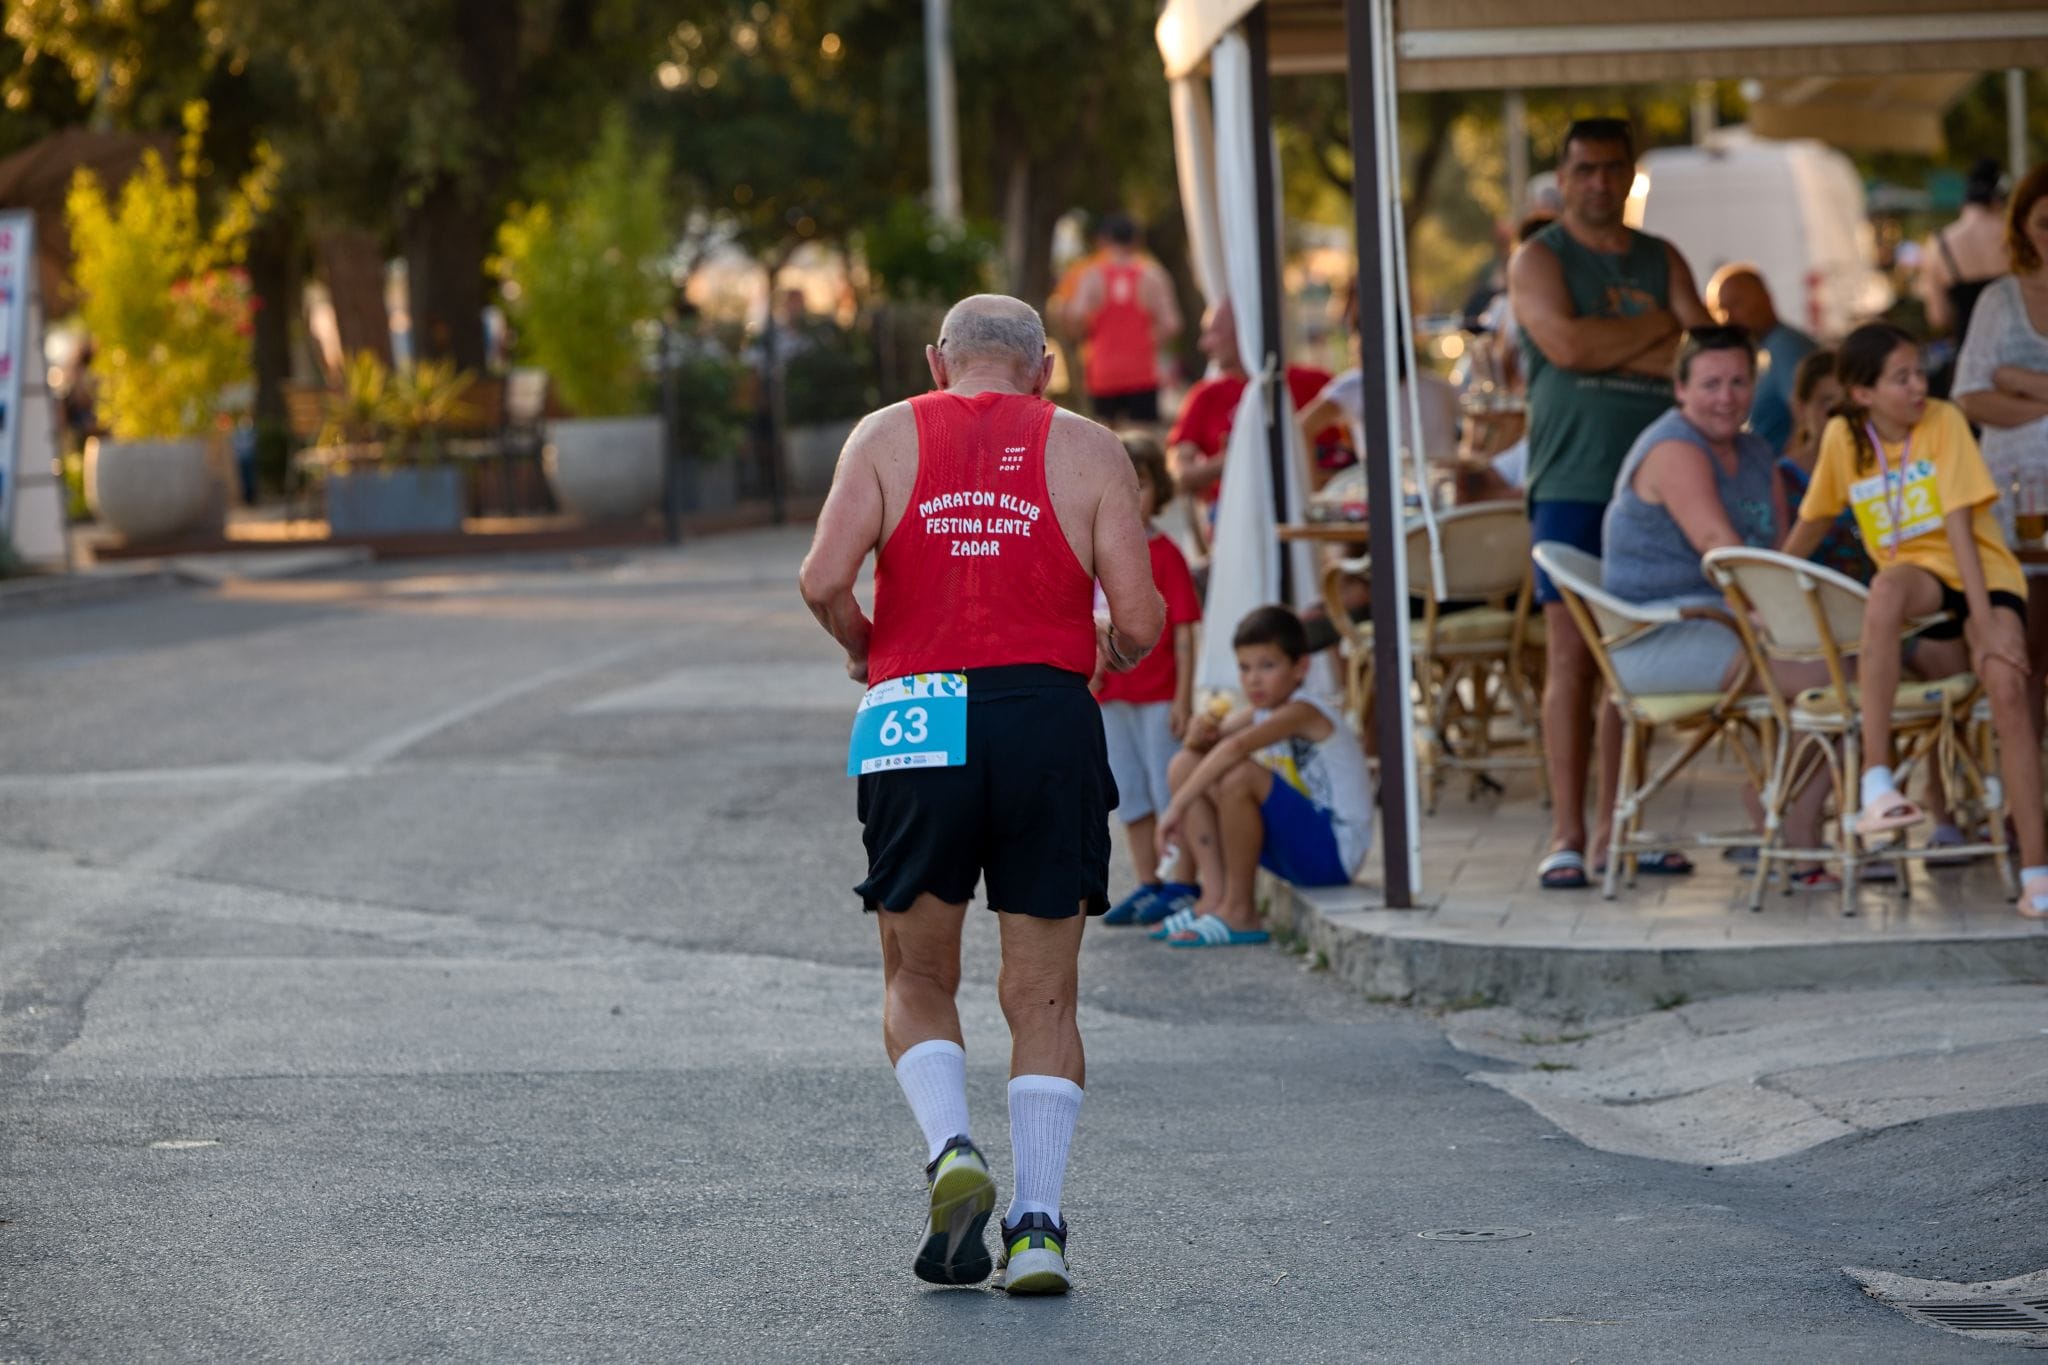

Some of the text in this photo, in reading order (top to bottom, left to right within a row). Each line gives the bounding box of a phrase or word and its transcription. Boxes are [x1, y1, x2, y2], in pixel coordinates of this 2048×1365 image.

[919, 491, 1040, 521] MARATON KLUB
[926, 517, 1031, 537] FESTINA LENTE
[951, 540, 1000, 556] ZADAR
[879, 706, 929, 747] 63
